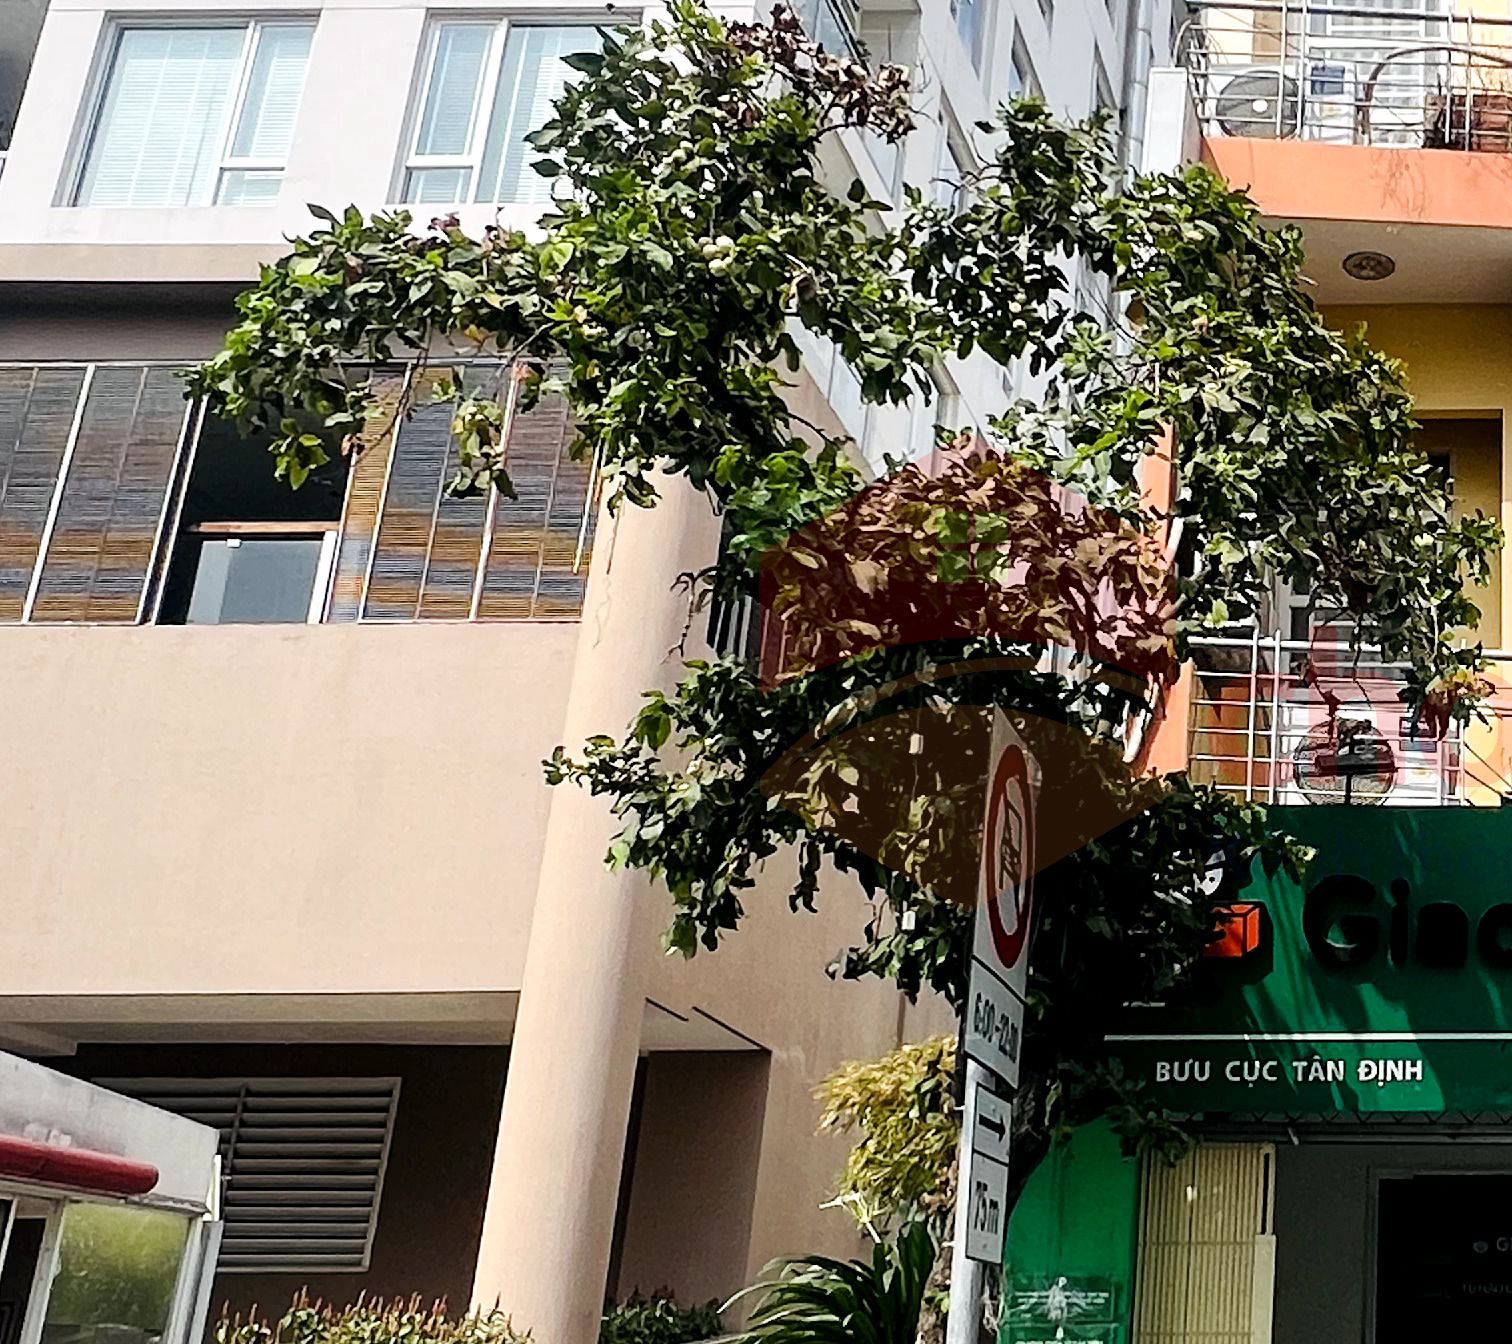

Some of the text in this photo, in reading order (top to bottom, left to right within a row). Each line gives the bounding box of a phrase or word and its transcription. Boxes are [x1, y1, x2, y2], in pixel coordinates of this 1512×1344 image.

[1155, 1055, 1424, 1088] BƯU CỤC TÂN ĐỊNH
